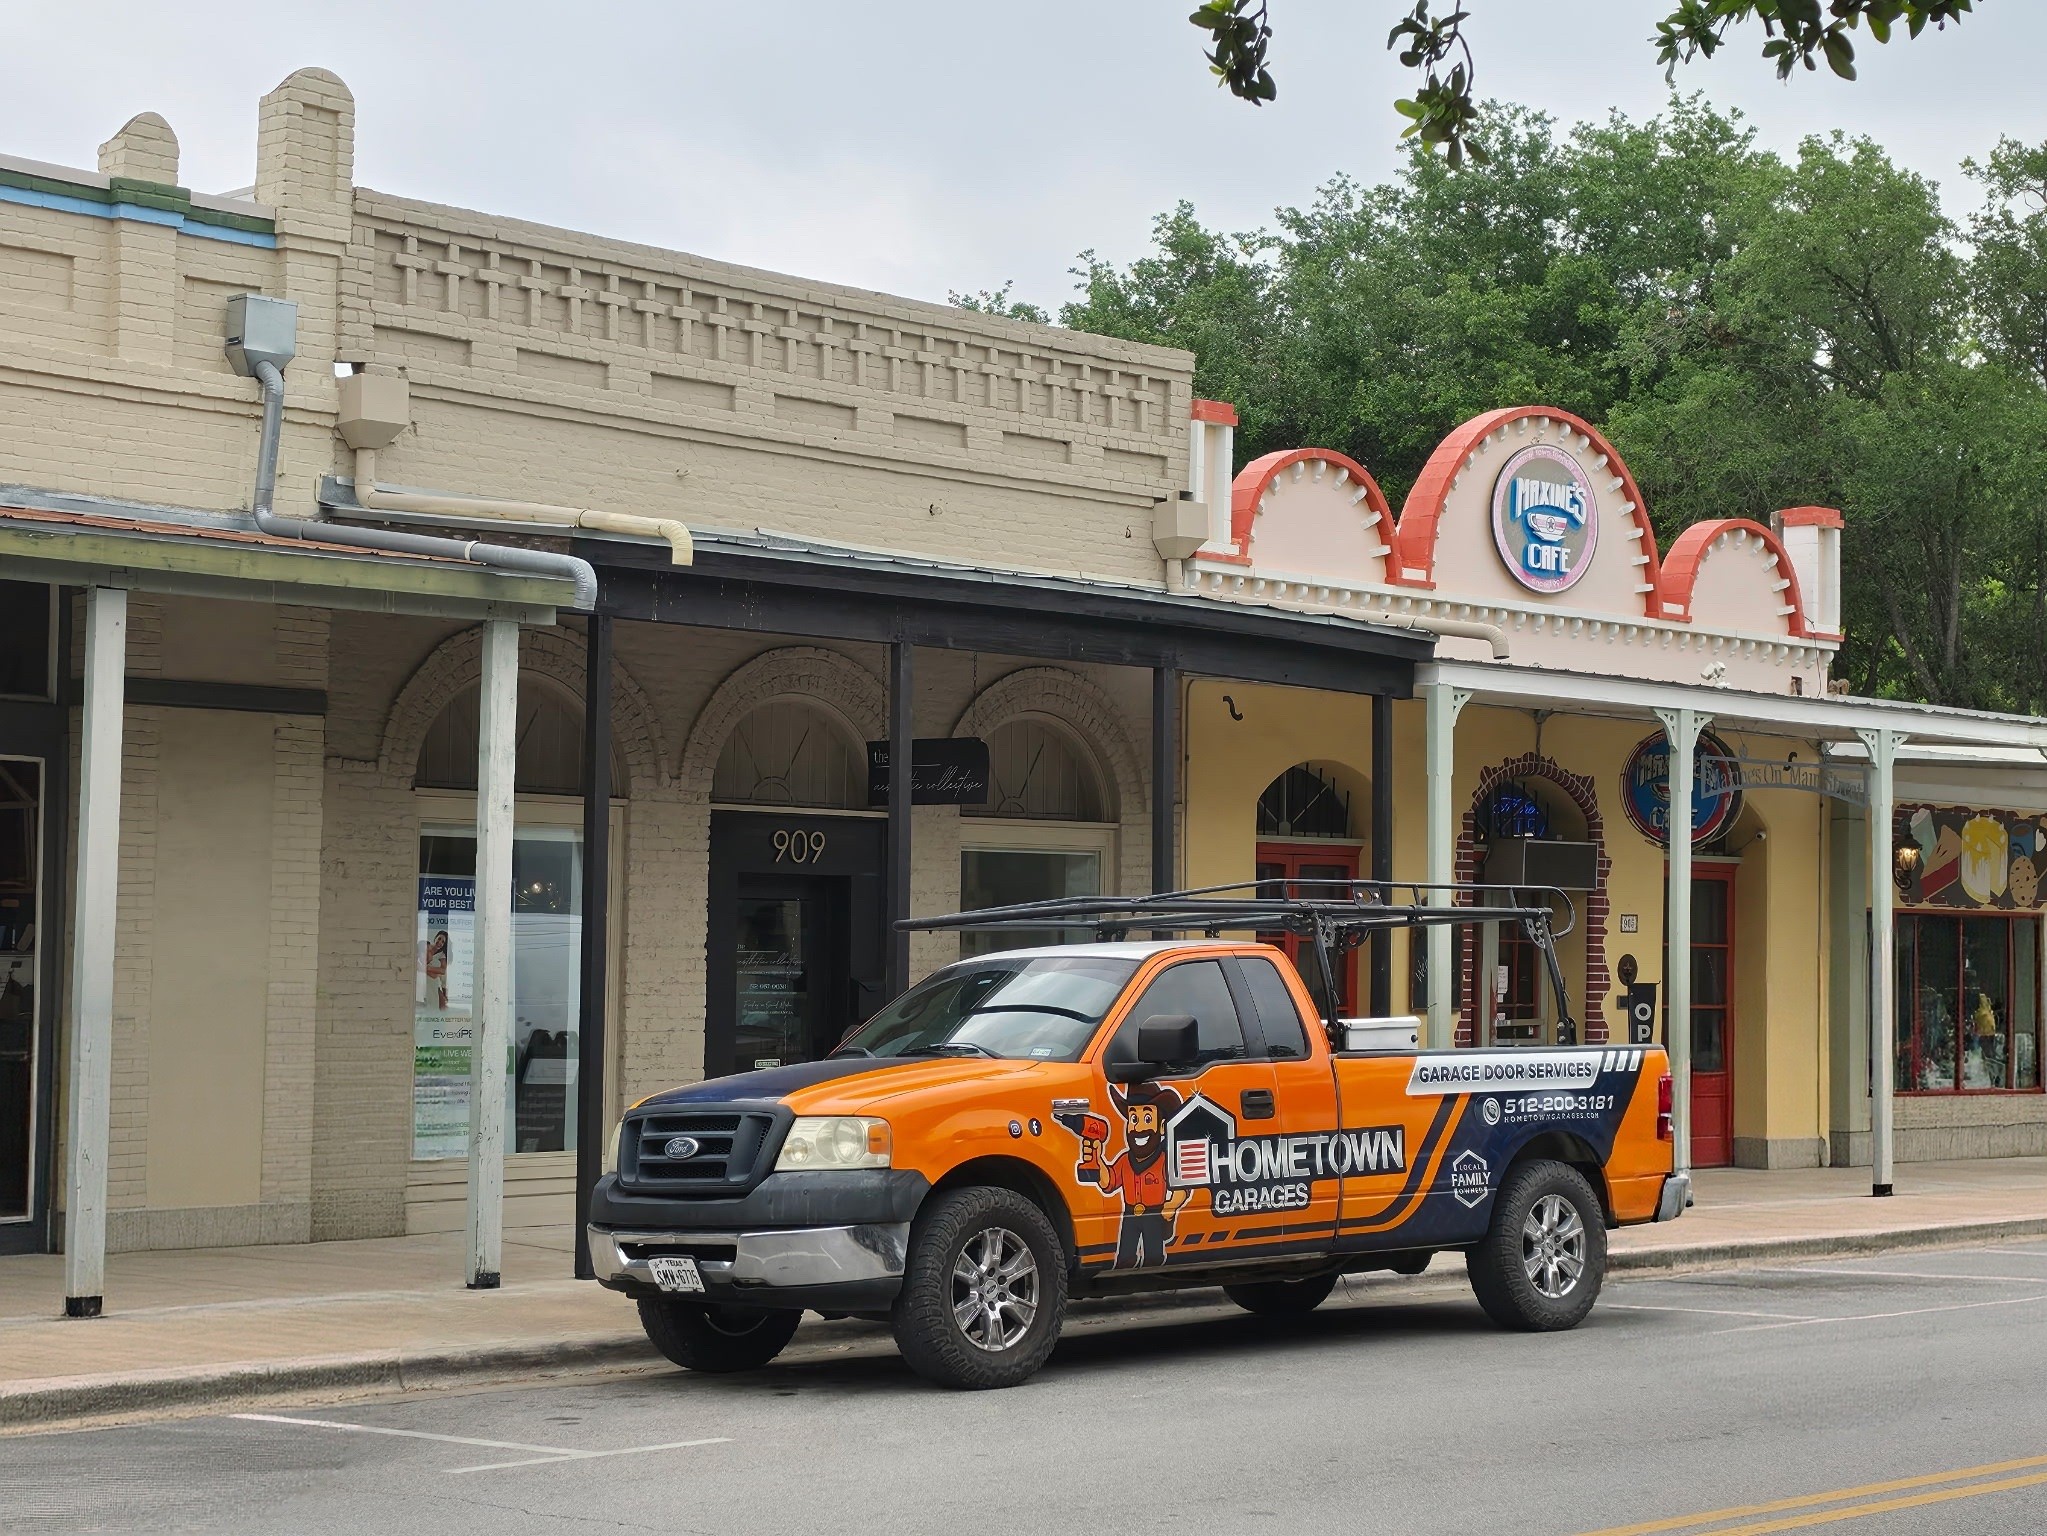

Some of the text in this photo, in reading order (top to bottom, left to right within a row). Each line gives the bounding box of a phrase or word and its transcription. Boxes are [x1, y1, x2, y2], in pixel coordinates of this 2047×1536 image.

[1515, 477, 1587, 525] MAXINE'S
[1528, 543, 1571, 573] CAFE
[874, 749, 889, 763] the
[773, 829, 826, 864] 909
[424, 886, 443, 896] ARE
[444, 887, 463, 897] YOU
[422, 899, 472, 909] YOUR BEST
[1635, 1003, 1652, 1042] OP
[1418, 1061, 1592, 1083] GARAGE DOOR SERVICES
[1504, 1095, 1614, 1114] 512-200-3181
[1504, 1112, 1600, 1123] HOMETOWNGARAGES.COM
[670, 1140, 689, 1154] Ford
[1212, 1130, 1404, 1184] HOMETOWN
[1460, 1163, 1481, 1171] LOCAL
[1451, 1171, 1491, 1187] FAMILY
[1214, 1183, 1309, 1214] GARAGES
[665, 1259, 684, 1267] TEXAS
